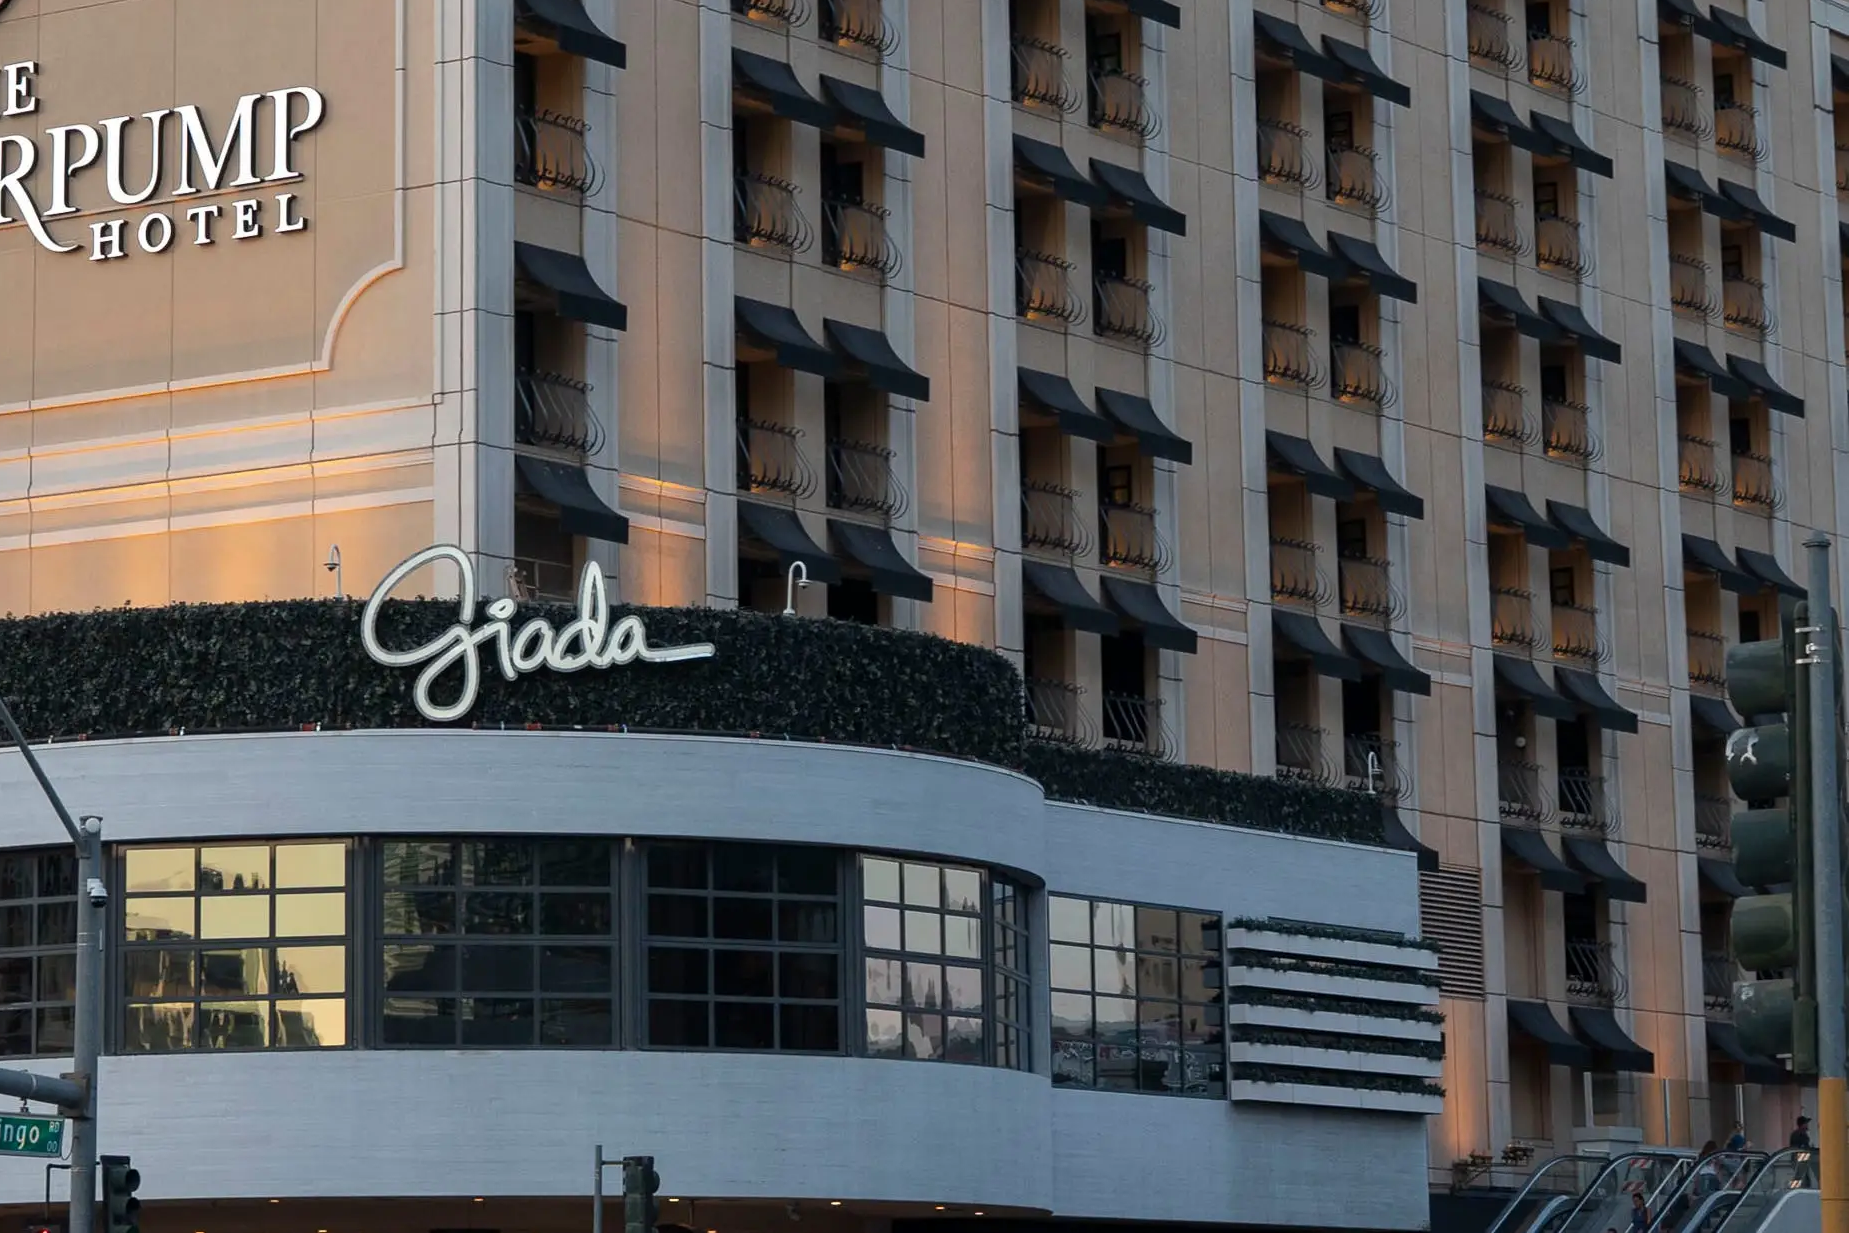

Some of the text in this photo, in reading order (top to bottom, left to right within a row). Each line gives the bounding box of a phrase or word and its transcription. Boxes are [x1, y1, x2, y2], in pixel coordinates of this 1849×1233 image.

[89, 193, 308, 261] HOTEL
[362, 544, 715, 720] Giada
[48, 1121, 60, 1133] RD
